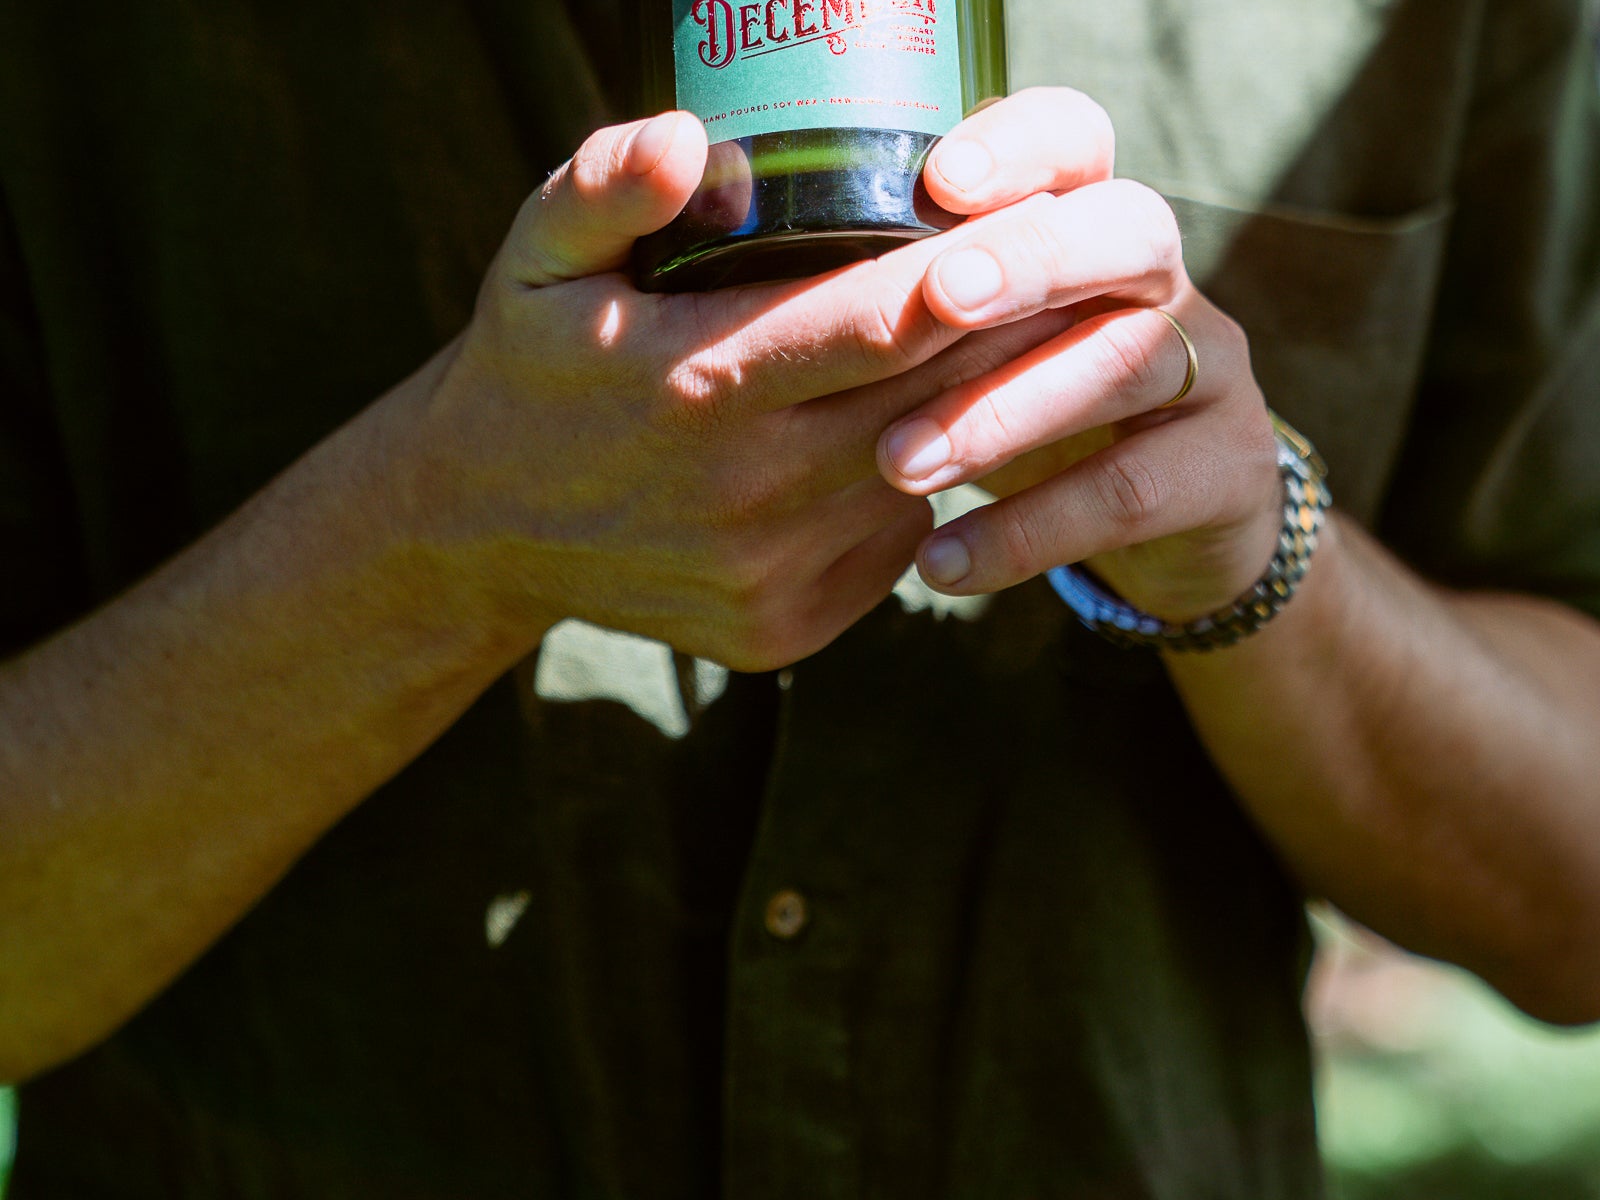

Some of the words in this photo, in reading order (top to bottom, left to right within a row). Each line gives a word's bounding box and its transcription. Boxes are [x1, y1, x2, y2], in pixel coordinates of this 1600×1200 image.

[703, 113, 727, 125] HAND
[730, 104, 769, 117] POURED
[773, 101, 791, 110] SOY
